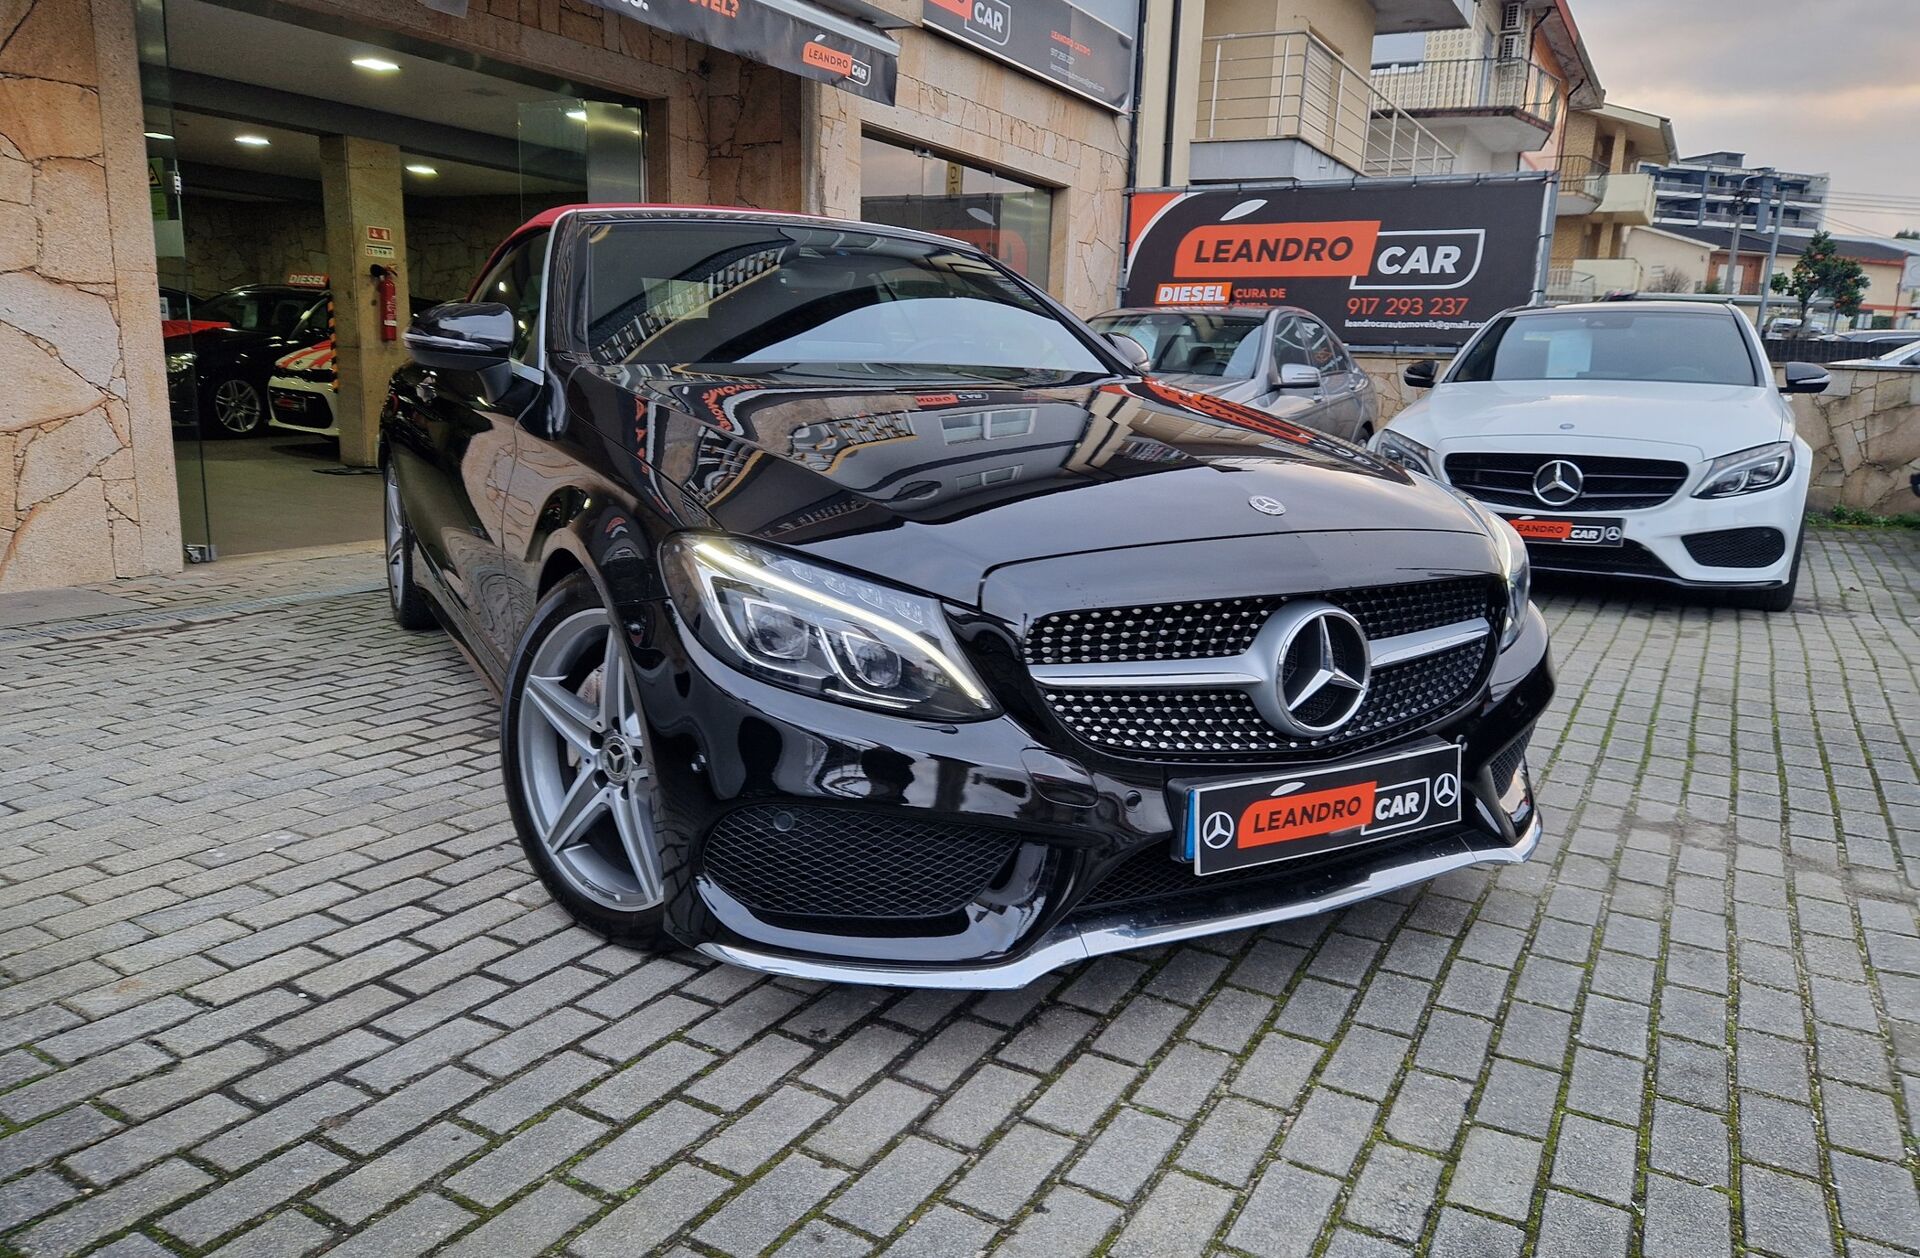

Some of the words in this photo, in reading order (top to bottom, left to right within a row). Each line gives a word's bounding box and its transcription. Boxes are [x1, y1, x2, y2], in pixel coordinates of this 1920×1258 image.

[974, 2, 1003, 33] CAR
[808, 48, 848, 69] LEANDRO
[851, 64, 867, 80] CAR
[1194, 236, 1354, 263] LEANDRO
[1377, 246, 1461, 275] CAR
[289, 274, 326, 286] DIESEL
[1159, 286, 1226, 302] DIESEL
[1235, 288, 1267, 298] CURA
[1269, 288, 1286, 298] DE
[1346, 297, 1380, 315] 917
[1385, 297, 1423, 315] 293
[1429, 297, 1469, 315] 237
[1516, 524, 1563, 534] EANDRO
[1571, 530, 1598, 539] CAR
[1253, 796, 1361, 833] LEANDRO
[1375, 792, 1419, 820] CAR
